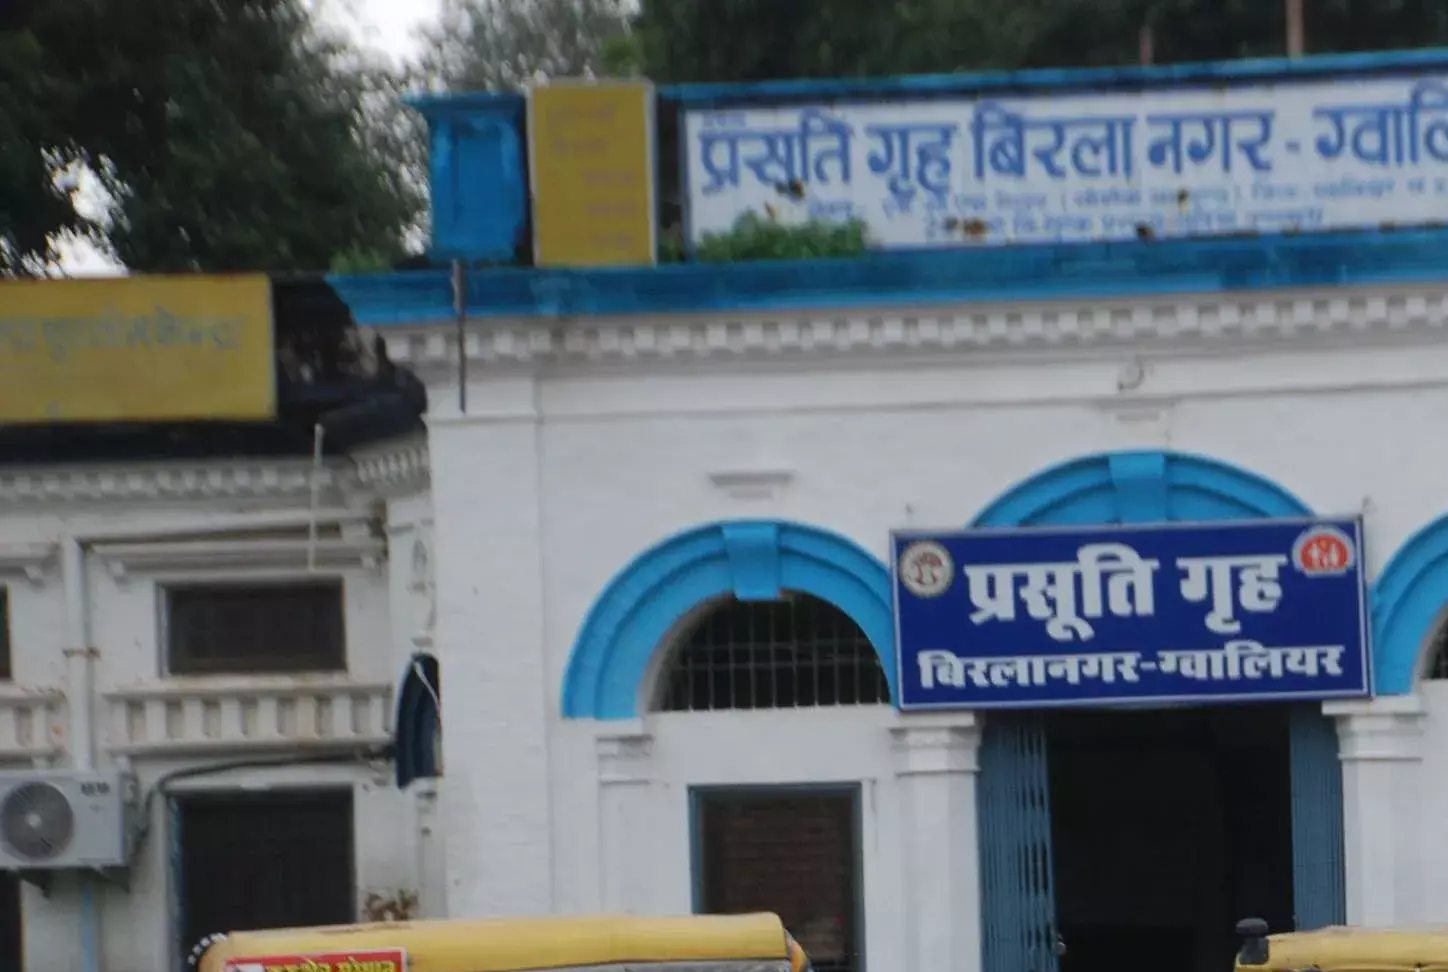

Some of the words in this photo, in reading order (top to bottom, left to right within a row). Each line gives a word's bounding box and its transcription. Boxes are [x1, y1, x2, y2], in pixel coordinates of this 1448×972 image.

[865, 121, 959, 209] गृह
[970, 96, 1137, 181] बिरला
[1146, 108, 1276, 173] नगर
[963, 542, 1160, 641] प्रसूति
[1176, 554, 1288, 634] गृह
